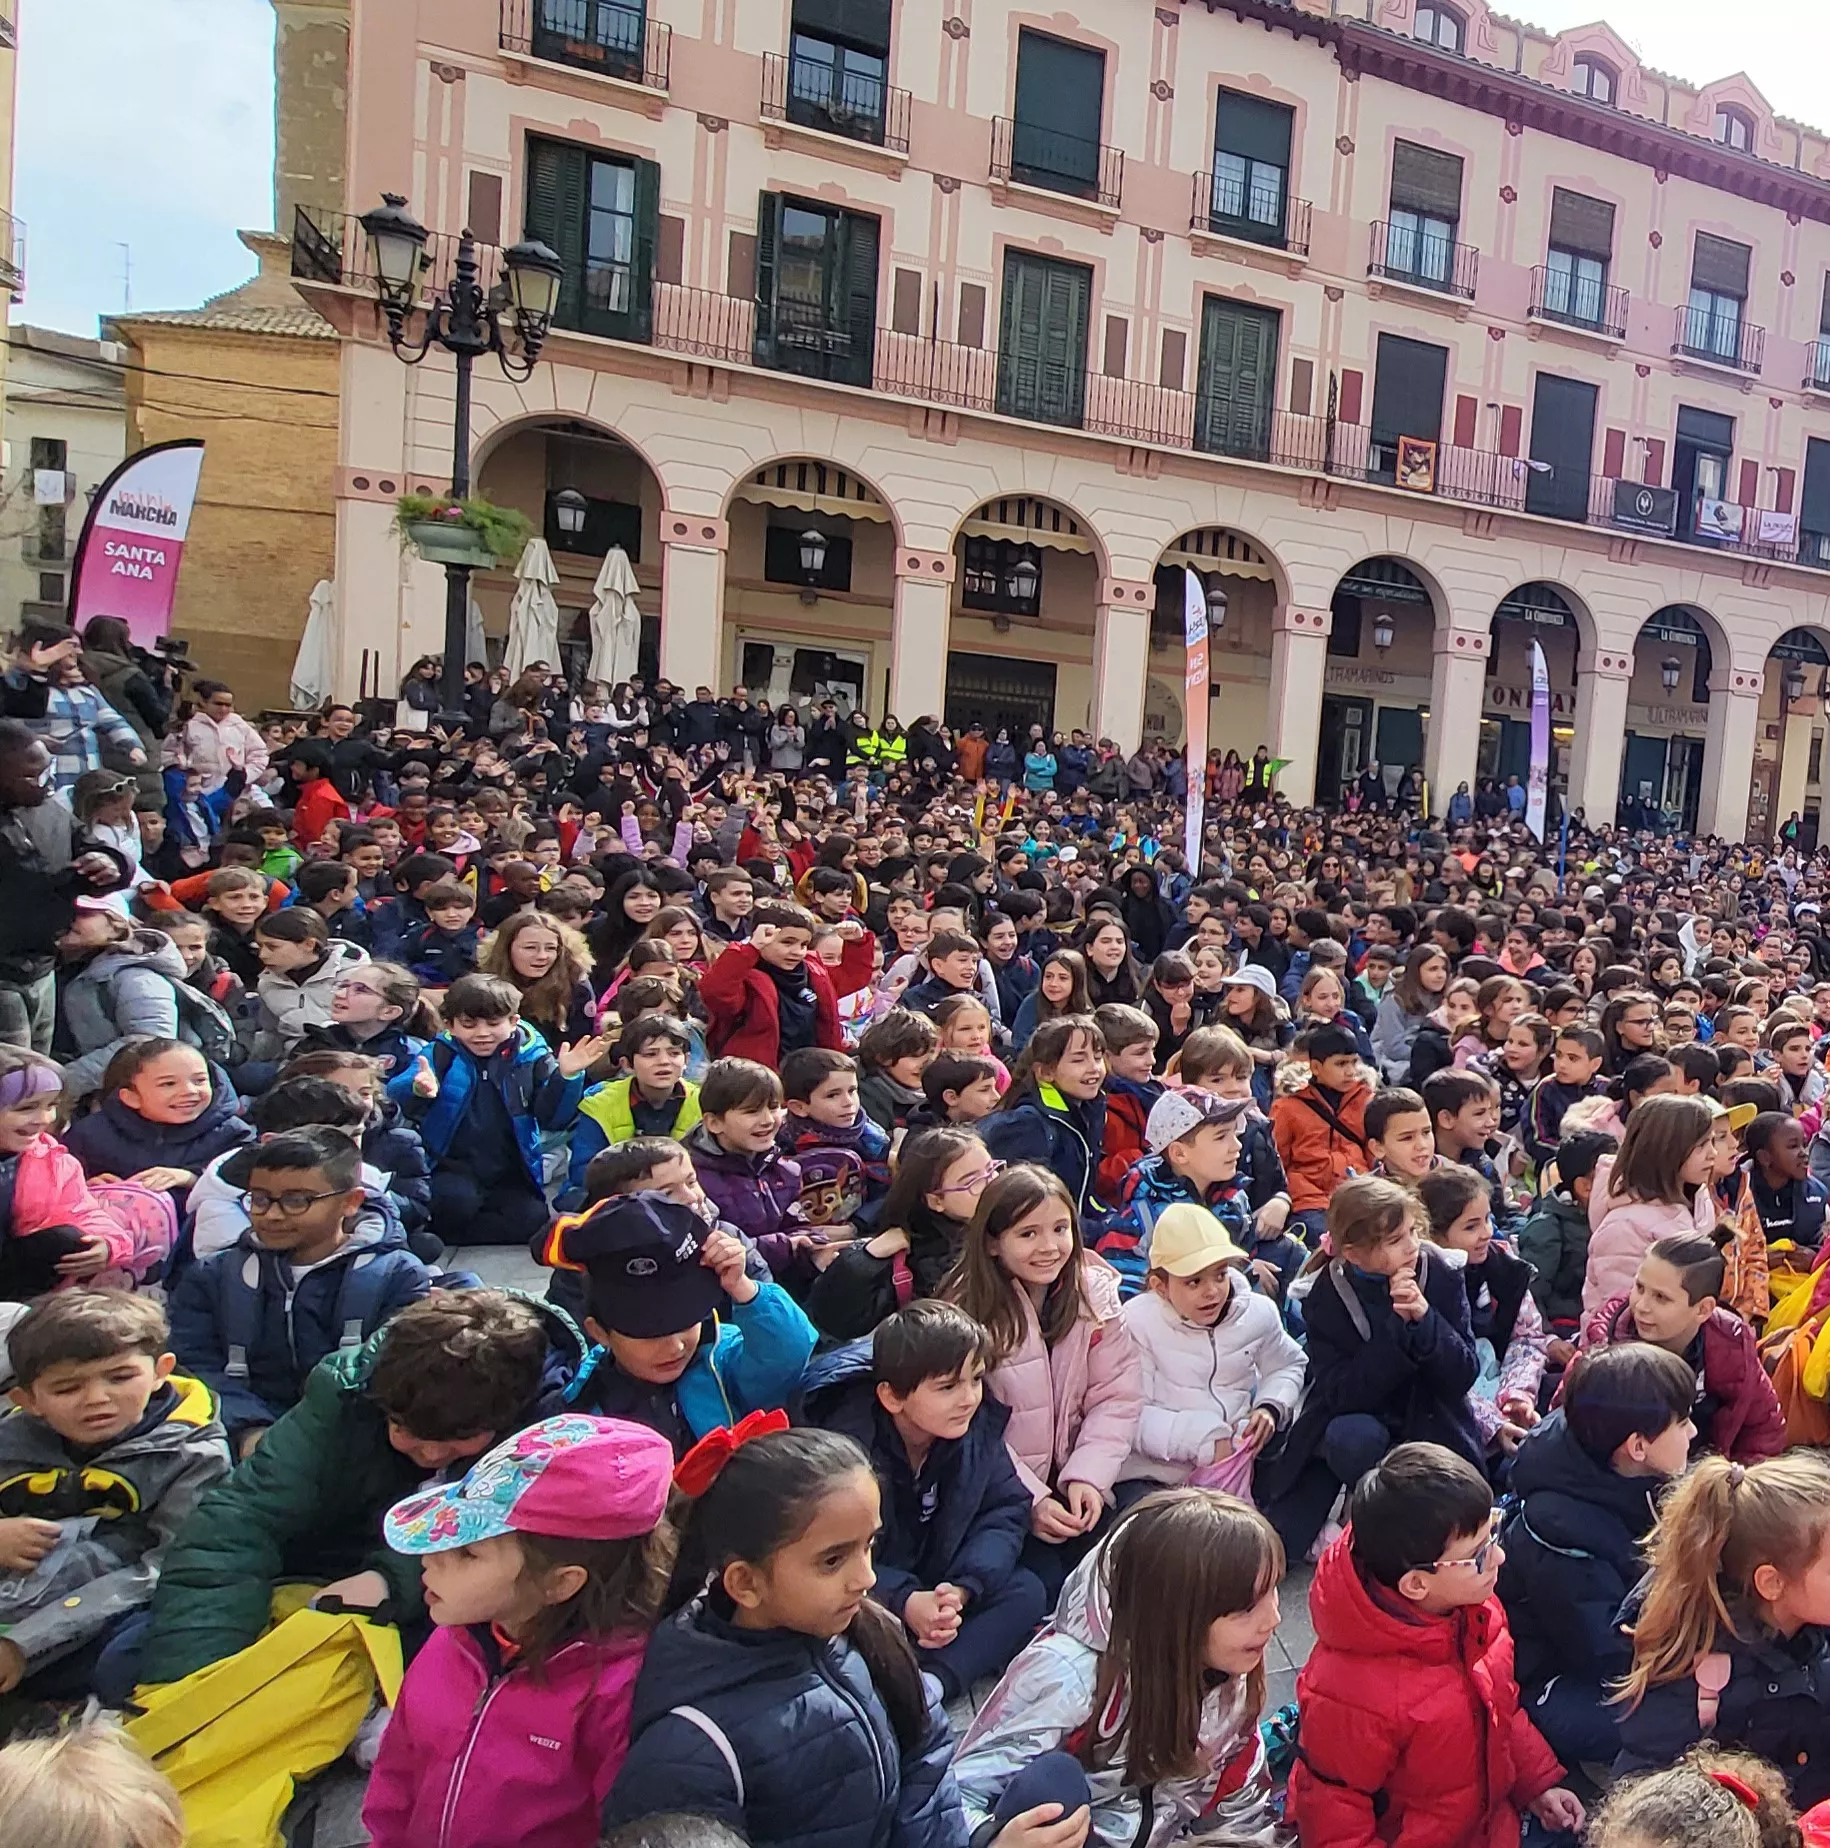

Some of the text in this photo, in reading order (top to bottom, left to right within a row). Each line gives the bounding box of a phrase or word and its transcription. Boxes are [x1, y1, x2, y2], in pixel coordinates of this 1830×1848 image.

[109, 499, 177, 527] MARCHA
[104, 541, 166, 566] SANTA
[111, 560, 153, 580] ANA
[1326, 666, 1395, 684] TRAMARINOS
